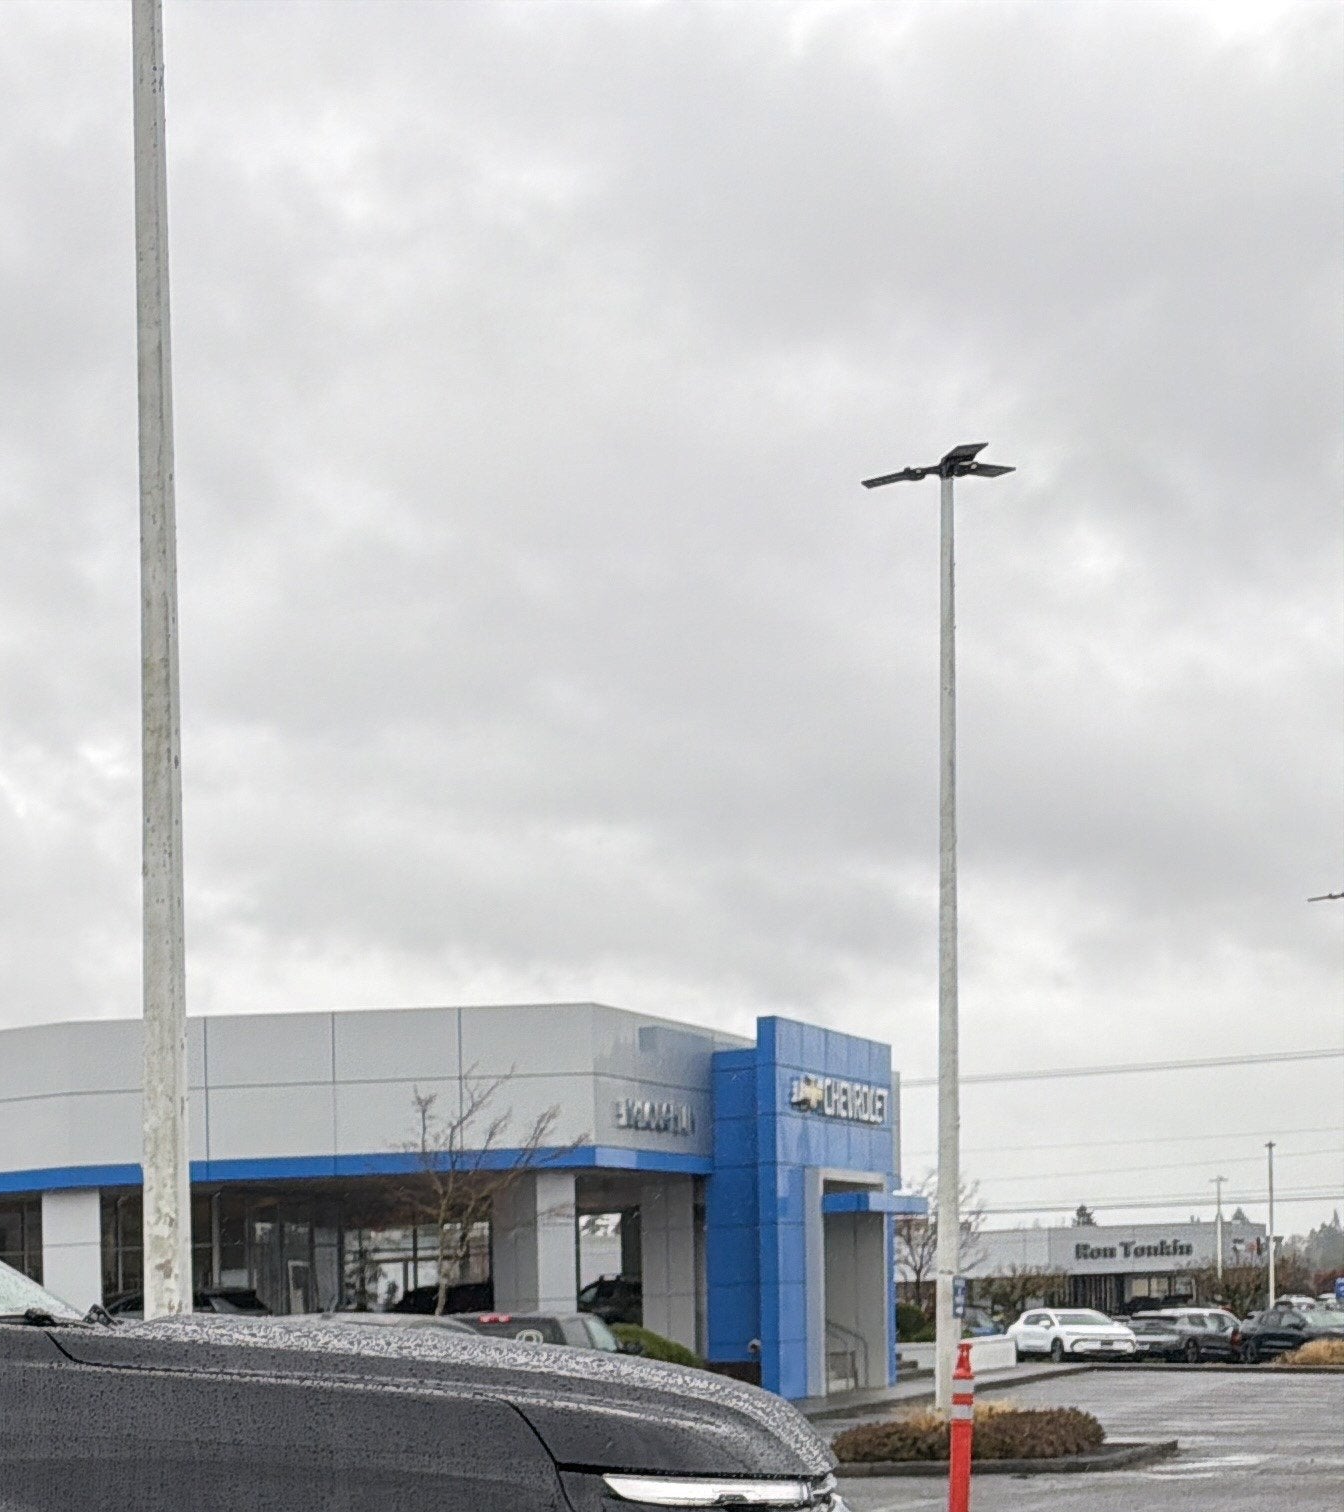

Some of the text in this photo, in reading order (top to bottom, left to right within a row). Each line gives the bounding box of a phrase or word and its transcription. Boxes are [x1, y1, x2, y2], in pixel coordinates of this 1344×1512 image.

[824, 1077, 889, 1123] CHEVROLET
[1075, 1239, 1193, 1260] Ron Tonkin
